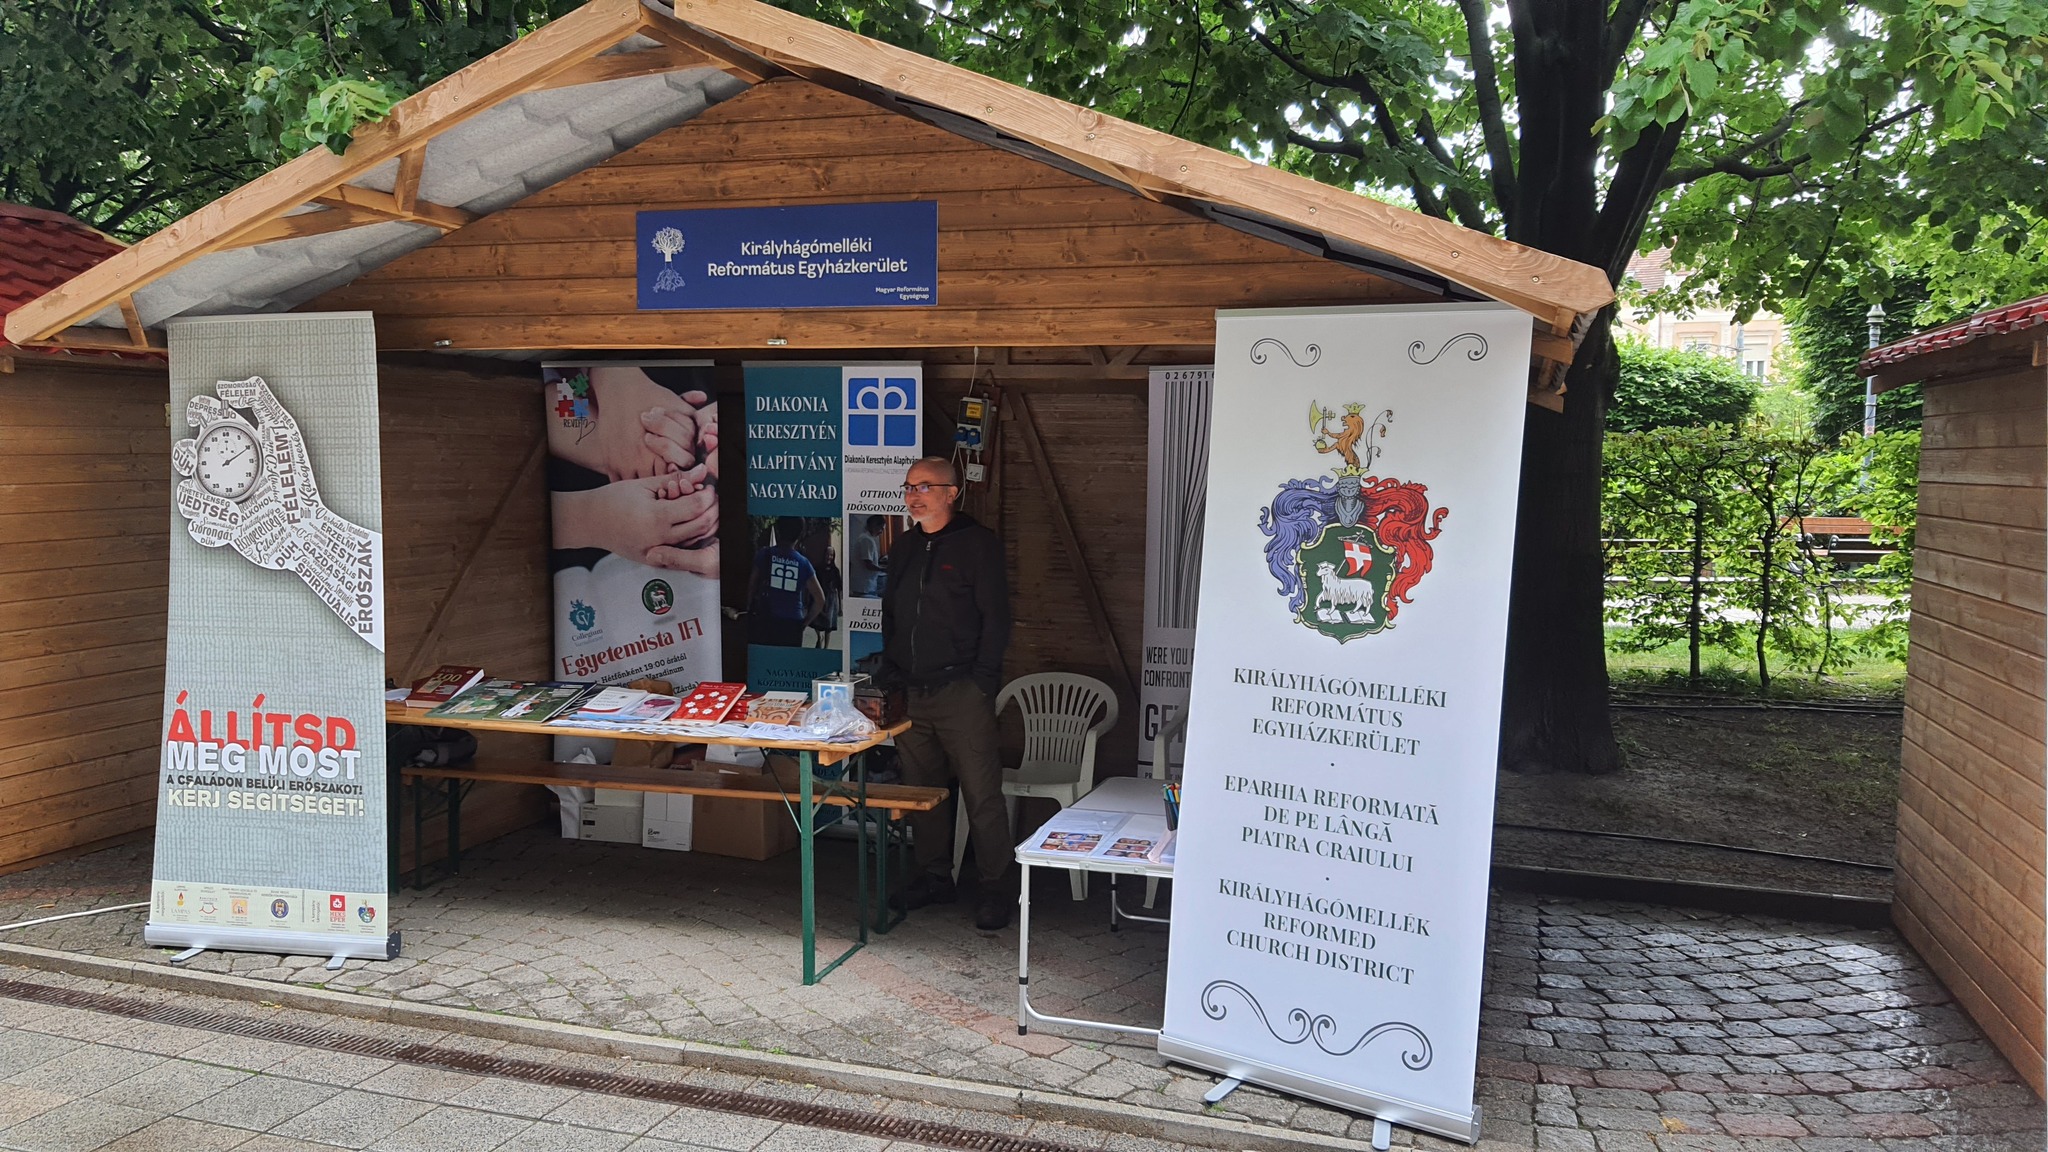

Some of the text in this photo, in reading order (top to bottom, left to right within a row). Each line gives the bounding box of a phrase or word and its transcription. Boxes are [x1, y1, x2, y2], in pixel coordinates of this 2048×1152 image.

[741, 237, 872, 258] Királyhágómelléki
[707, 260, 908, 279] Református Egyházkerület
[875, 286, 896, 294] Magyar
[220, 389, 256, 398] FÉLELEM
[255, 378, 295, 429] ELSZIGETELTSÉG
[755, 396, 829, 412] DIAKONIA
[748, 421, 837, 440] KERESZTYÉN
[173, 448, 194, 474] DÜH
[291, 430, 320, 508] Kétségbeesés
[749, 451, 837, 471] ALAPÍTVÁNY
[844, 455, 920, 468] Diakonia Keresztyén Alapítván
[275, 433, 301, 525] FÉLELEM
[750, 480, 838, 500] NAGYVÁRAD
[178, 492, 240, 525] IJEDTSÉG
[179, 485, 231, 508] TEHETETLENSÉG
[241, 495, 274, 523] ALKOHOL
[847, 501, 909, 513] IDŐSGONDOZ
[860, 490, 902, 499] OTTHONI
[275, 508, 287, 524] DÜH
[200, 537, 216, 546] DÜH
[320, 521, 357, 552] ÉRZELMI
[275, 540, 299, 568] DÜH
[323, 549, 357, 579] SZEXUÁLIS
[325, 537, 357, 567] TESTI
[772, 555, 799, 567] Diakónia
[302, 541, 357, 594] GAZDASÁGI
[295, 562, 358, 627] SPIRITUÁLIS
[355, 540, 373, 634] ERŐSZAK
[561, 617, 704, 677] Egyetemista IFI
[1146, 646, 1188, 665] WERE YOU
[601, 666, 643, 684] Hétfőnként
[644, 659, 666, 672] 19:00
[666, 652, 688, 665] órától
[1144, 669, 1191, 688] CONFRONT
[1233, 667, 1448, 708] KIRÁLYHÁGÓMELLÉKI
[167, 689, 357, 754] ÁLLÍTSD
[1271, 696, 1403, 728] REFORMÁTUS
[1253, 717, 1421, 756] EGYHÁZKERÜLET
[167, 741, 361, 780] MEG MOST
[166, 772, 363, 796] A CSALÁDON BELÜLI ERŐSZAKOT!
[168, 782, 365, 817] KÉRJ SEGÍTSÉGET!
[1224, 774, 1440, 826] EPARHIA REFORMATĂ
[1263, 805, 1393, 843] DE PE LÂNGĂ
[1241, 826, 1414, 873] PIATRA CRAIULUI
[1218, 878, 1431, 937] KIRÁLYHÁGÓMELLÉK
[1263, 911, 1377, 951] REFORMED
[1226, 929, 1415, 985] CHURCH DISTRICT
